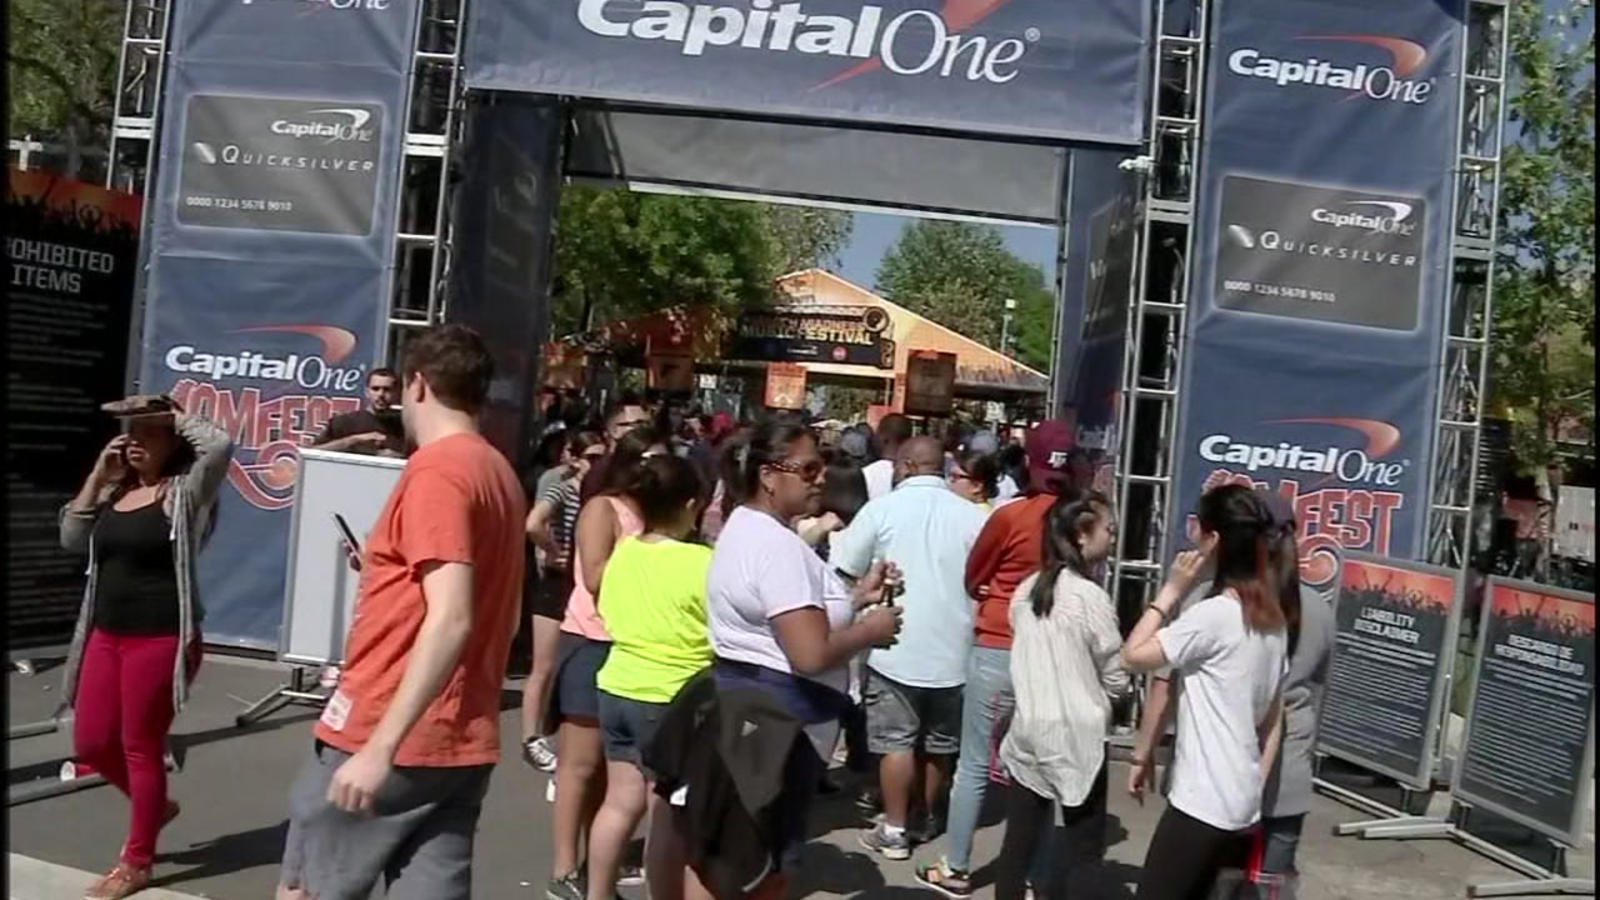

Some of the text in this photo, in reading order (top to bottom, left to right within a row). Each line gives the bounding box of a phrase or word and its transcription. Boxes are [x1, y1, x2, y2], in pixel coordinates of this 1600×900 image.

[221, 145, 375, 172] QUICKSILVER
[214, 198, 239, 209] 1234
[1259, 230, 1417, 267] QUICKSILVER
[10, 263, 82, 294] ITEMS
[1253, 283, 1280, 296] 1234
[798, 326, 874, 346] FESTIVAL
